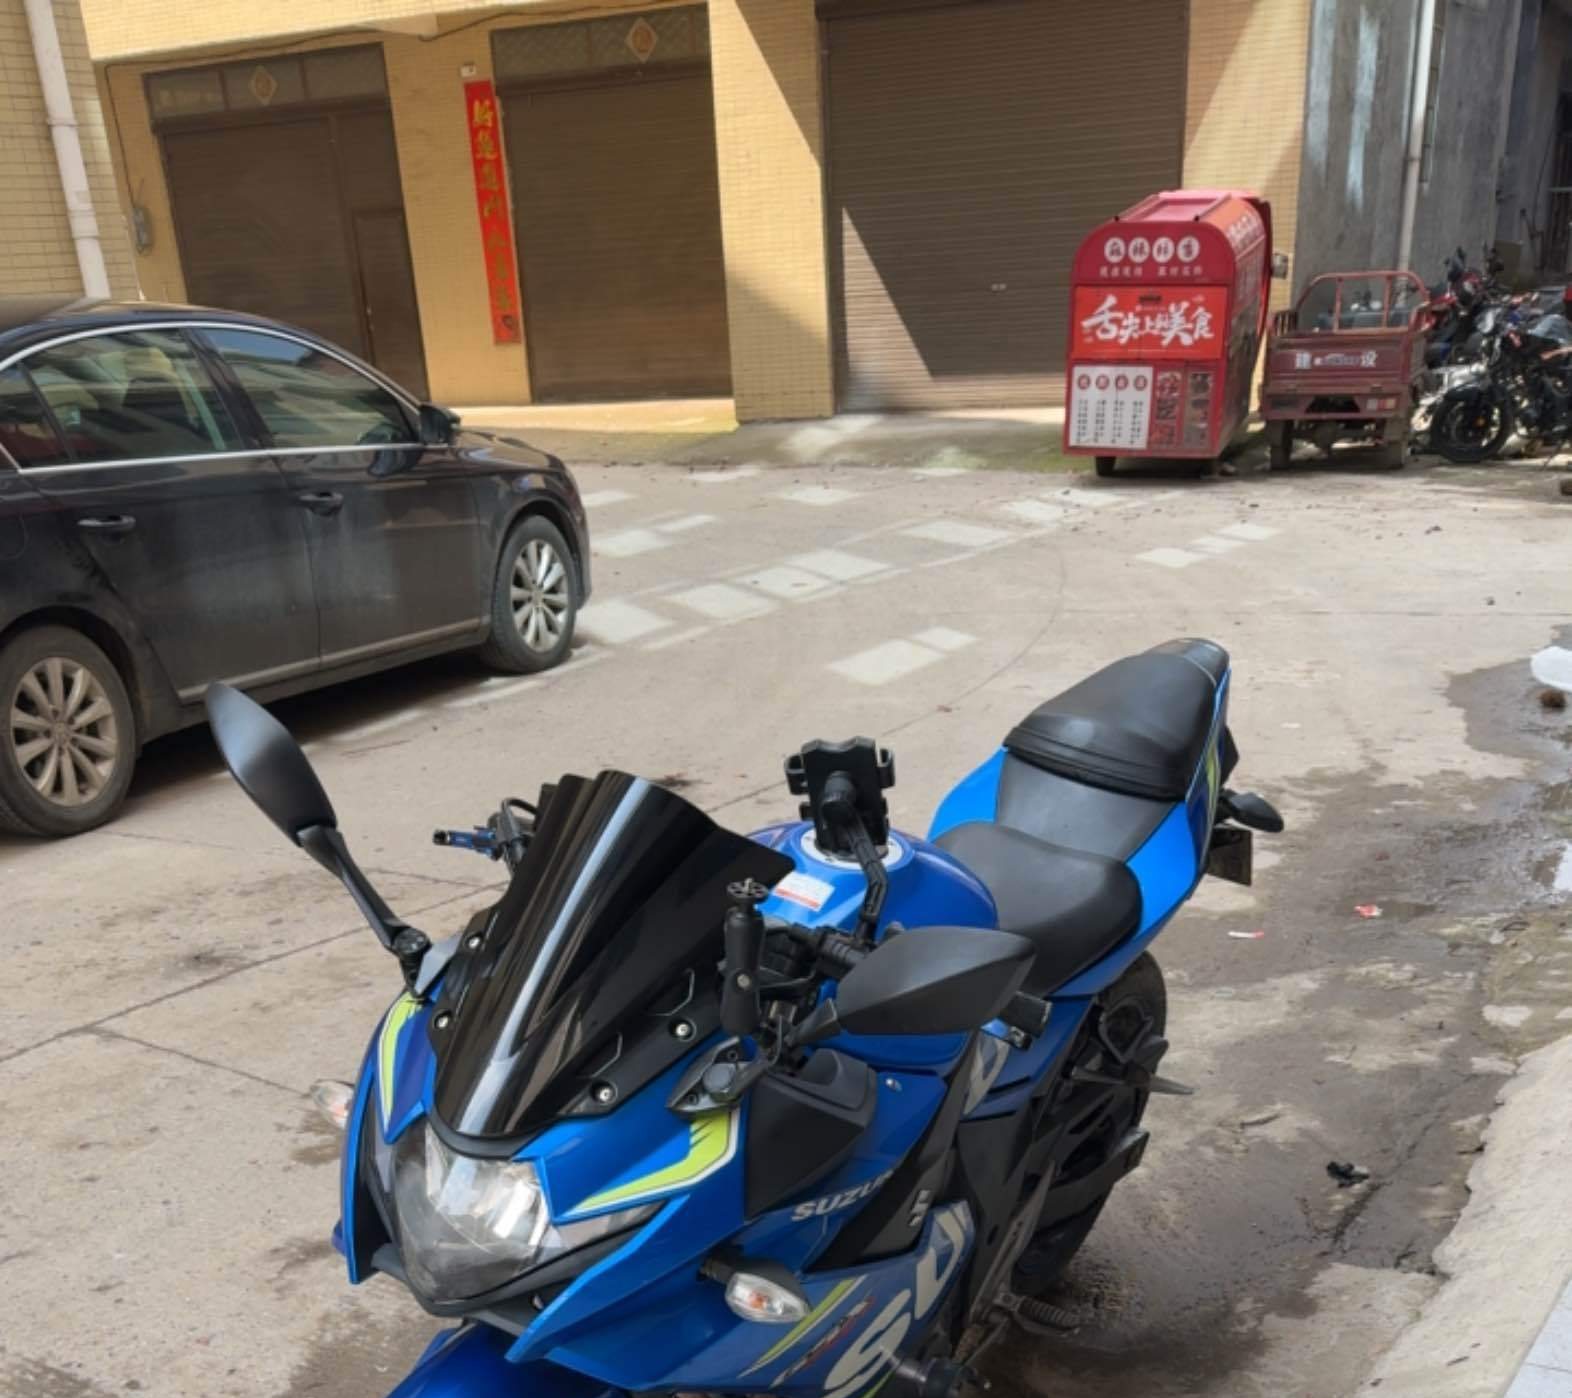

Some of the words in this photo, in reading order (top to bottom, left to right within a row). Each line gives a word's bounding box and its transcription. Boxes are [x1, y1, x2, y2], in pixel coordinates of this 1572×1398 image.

[1081, 294, 1214, 346] 舌尖上的美食
